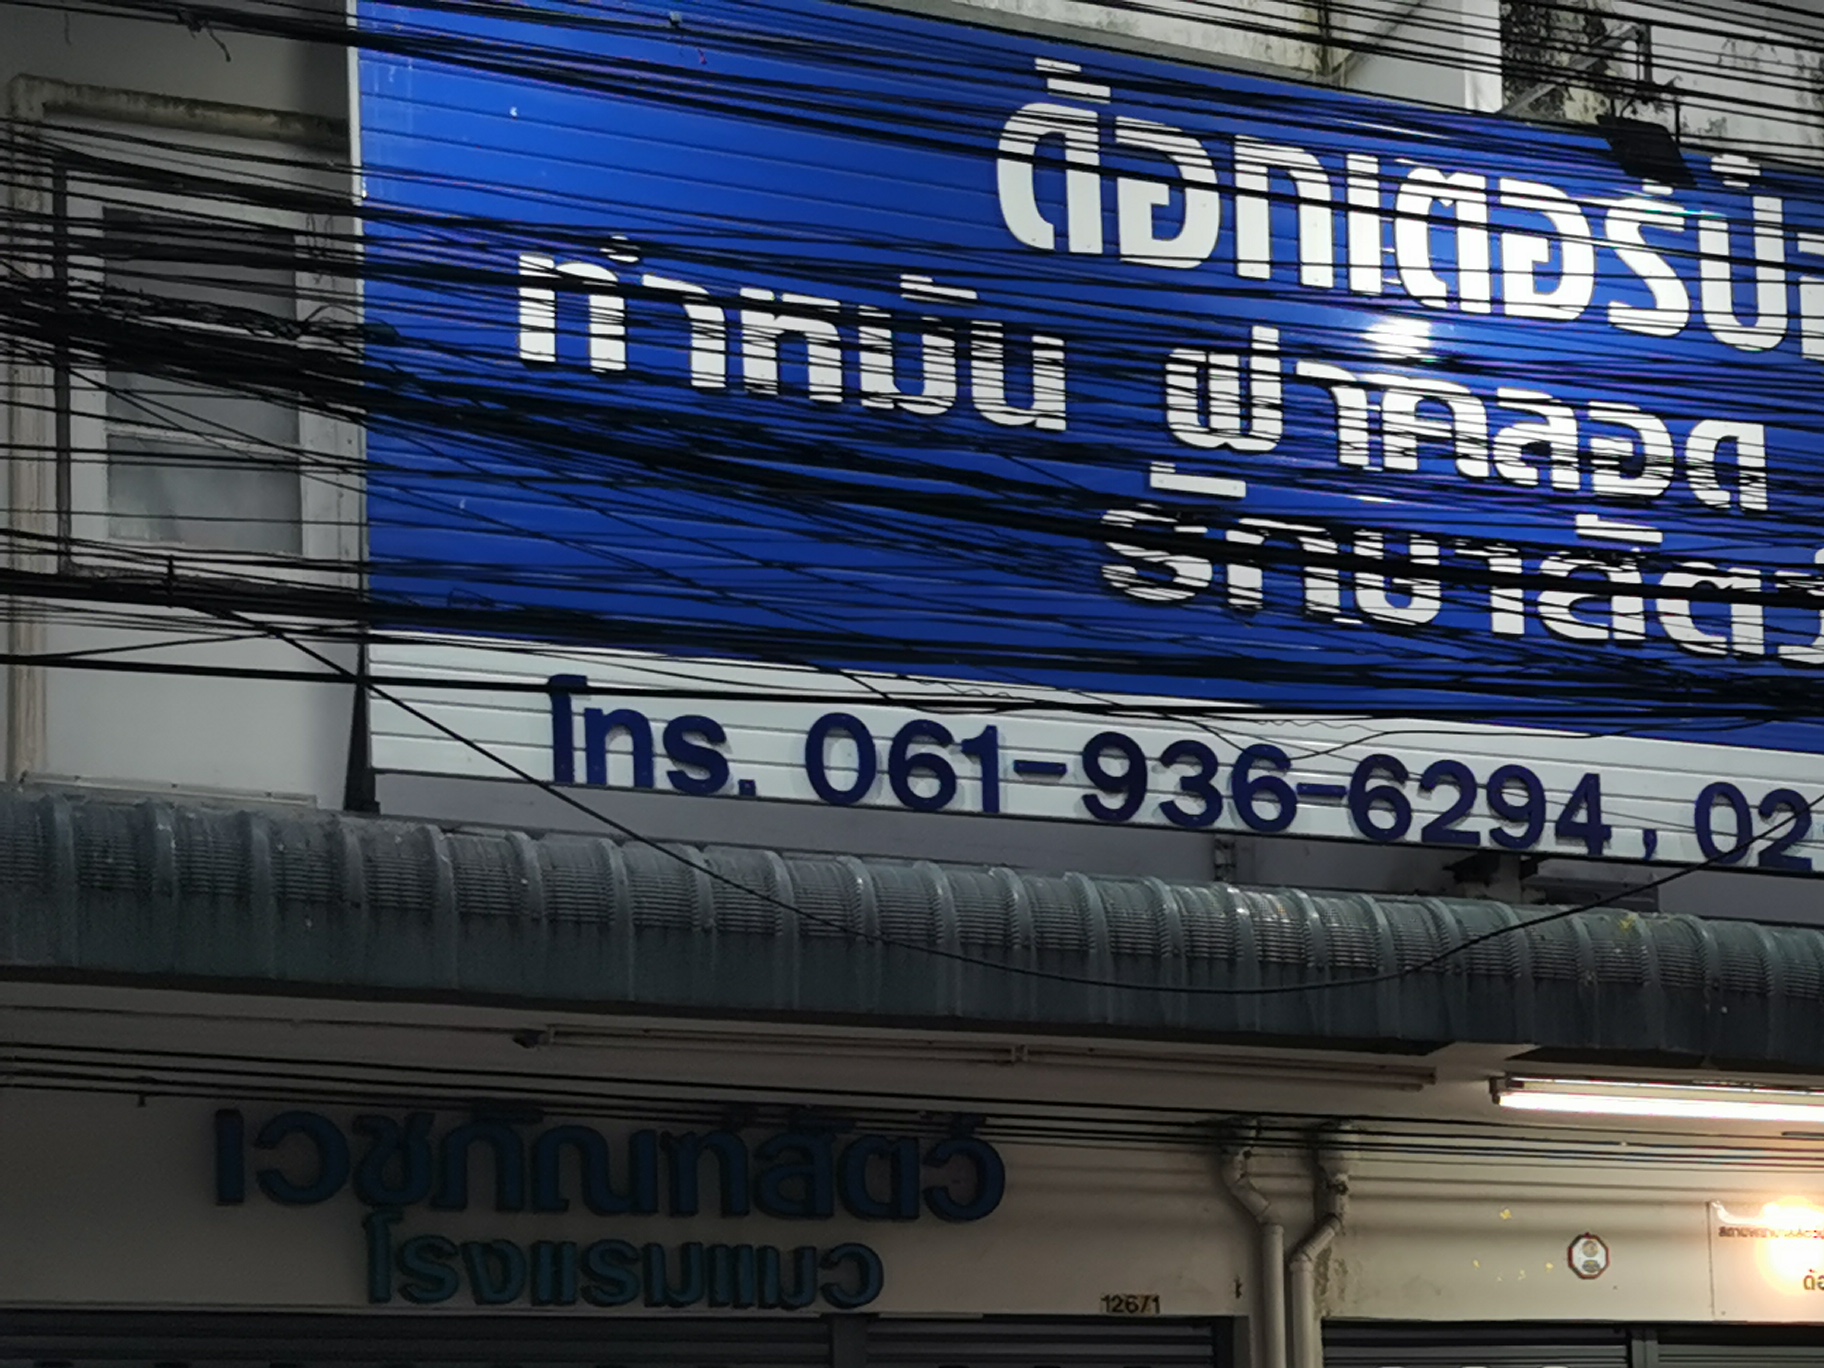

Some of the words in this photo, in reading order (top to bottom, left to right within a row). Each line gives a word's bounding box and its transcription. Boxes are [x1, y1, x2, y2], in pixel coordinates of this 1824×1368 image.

[517, 234, 1067, 431] ทำหมัน
[547, 673, 756, 798] โทร.
[359, 1204, 884, 1310] โรงแรมแมว
